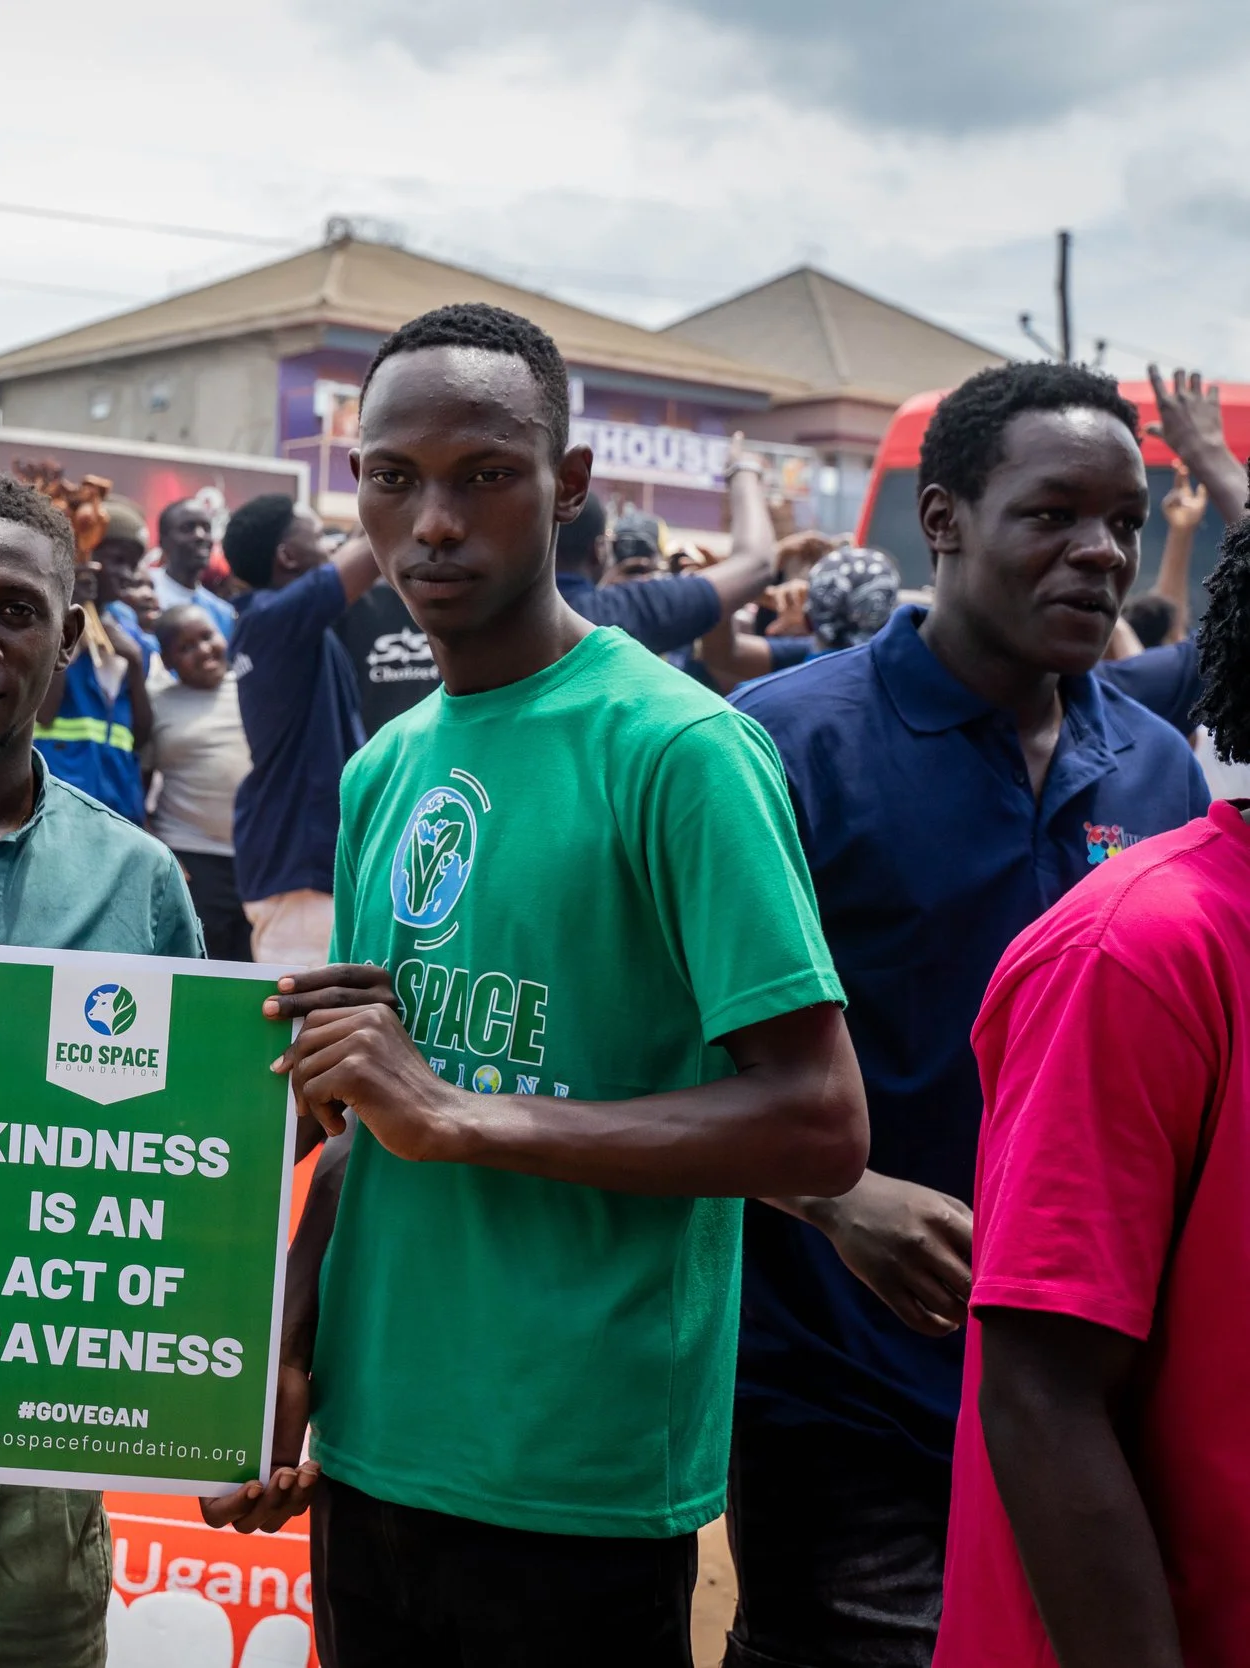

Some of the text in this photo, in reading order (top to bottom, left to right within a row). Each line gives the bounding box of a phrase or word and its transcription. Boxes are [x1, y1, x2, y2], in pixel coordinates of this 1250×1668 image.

[395, 958, 549, 1067] SPACE
[54, 1063, 159, 1078] FOUNDATION
[55, 1042, 160, 1068] ECO SPACE
[28, 1190, 165, 1241] IS AN
[0, 1255, 185, 1307] ACT OF
[17, 1400, 149, 1429] #GOVEGAN
